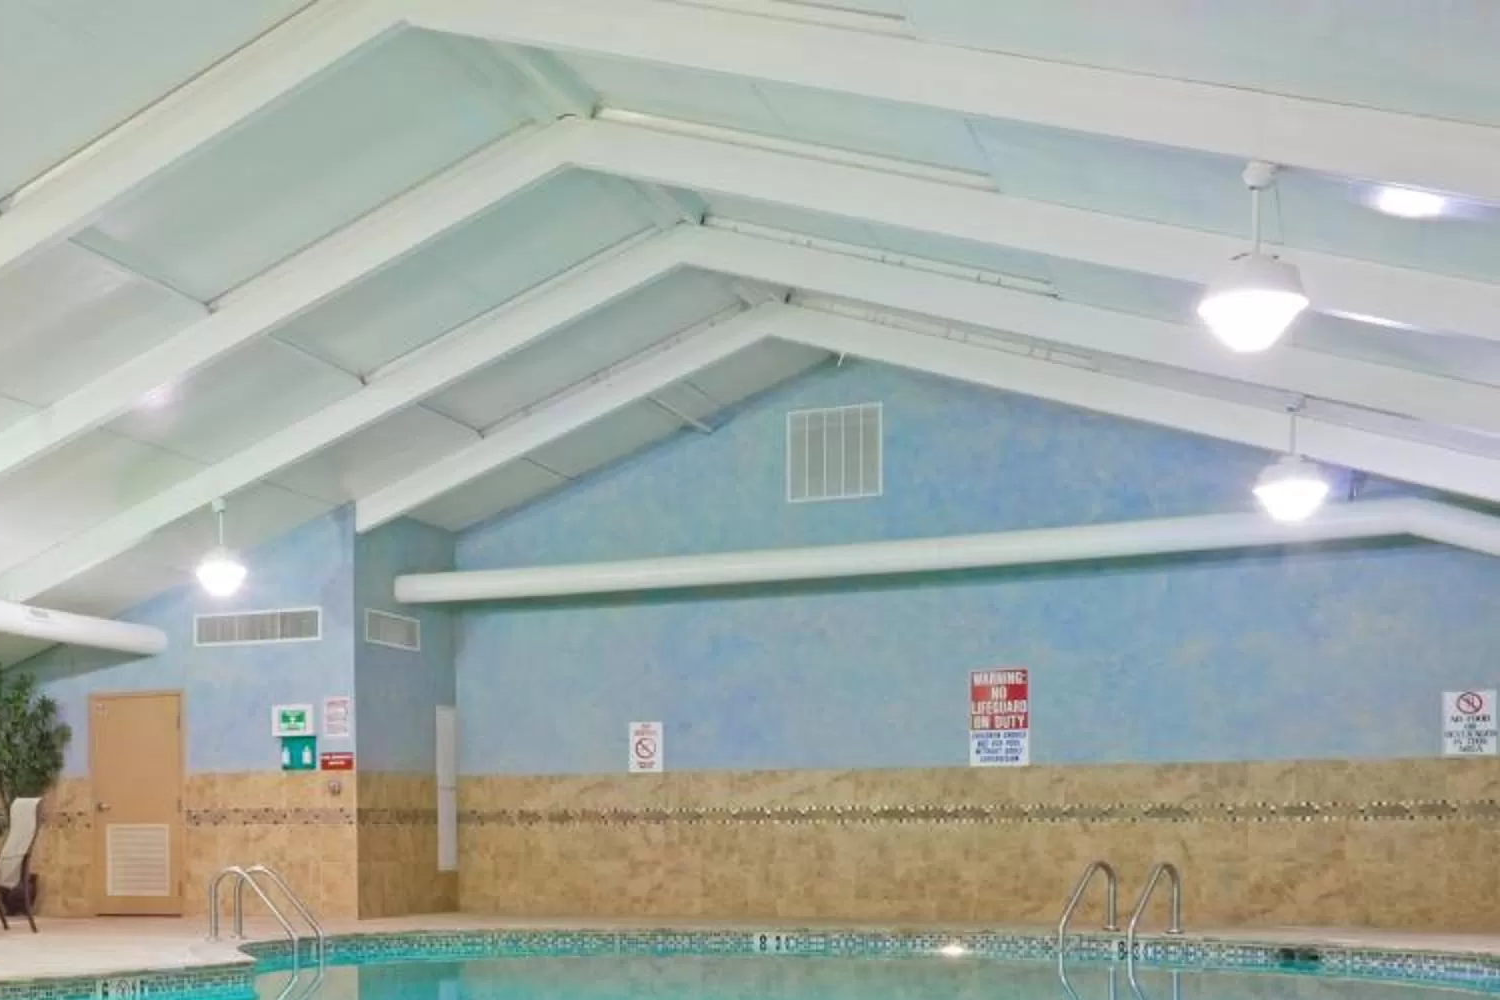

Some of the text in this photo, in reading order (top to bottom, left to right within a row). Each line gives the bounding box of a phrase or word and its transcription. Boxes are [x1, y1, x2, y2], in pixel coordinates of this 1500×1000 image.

[991, 686, 1007, 700] NO
[971, 701, 1027, 714] LIFEGUARD
[973, 715, 1024, 729] ON DUTY
